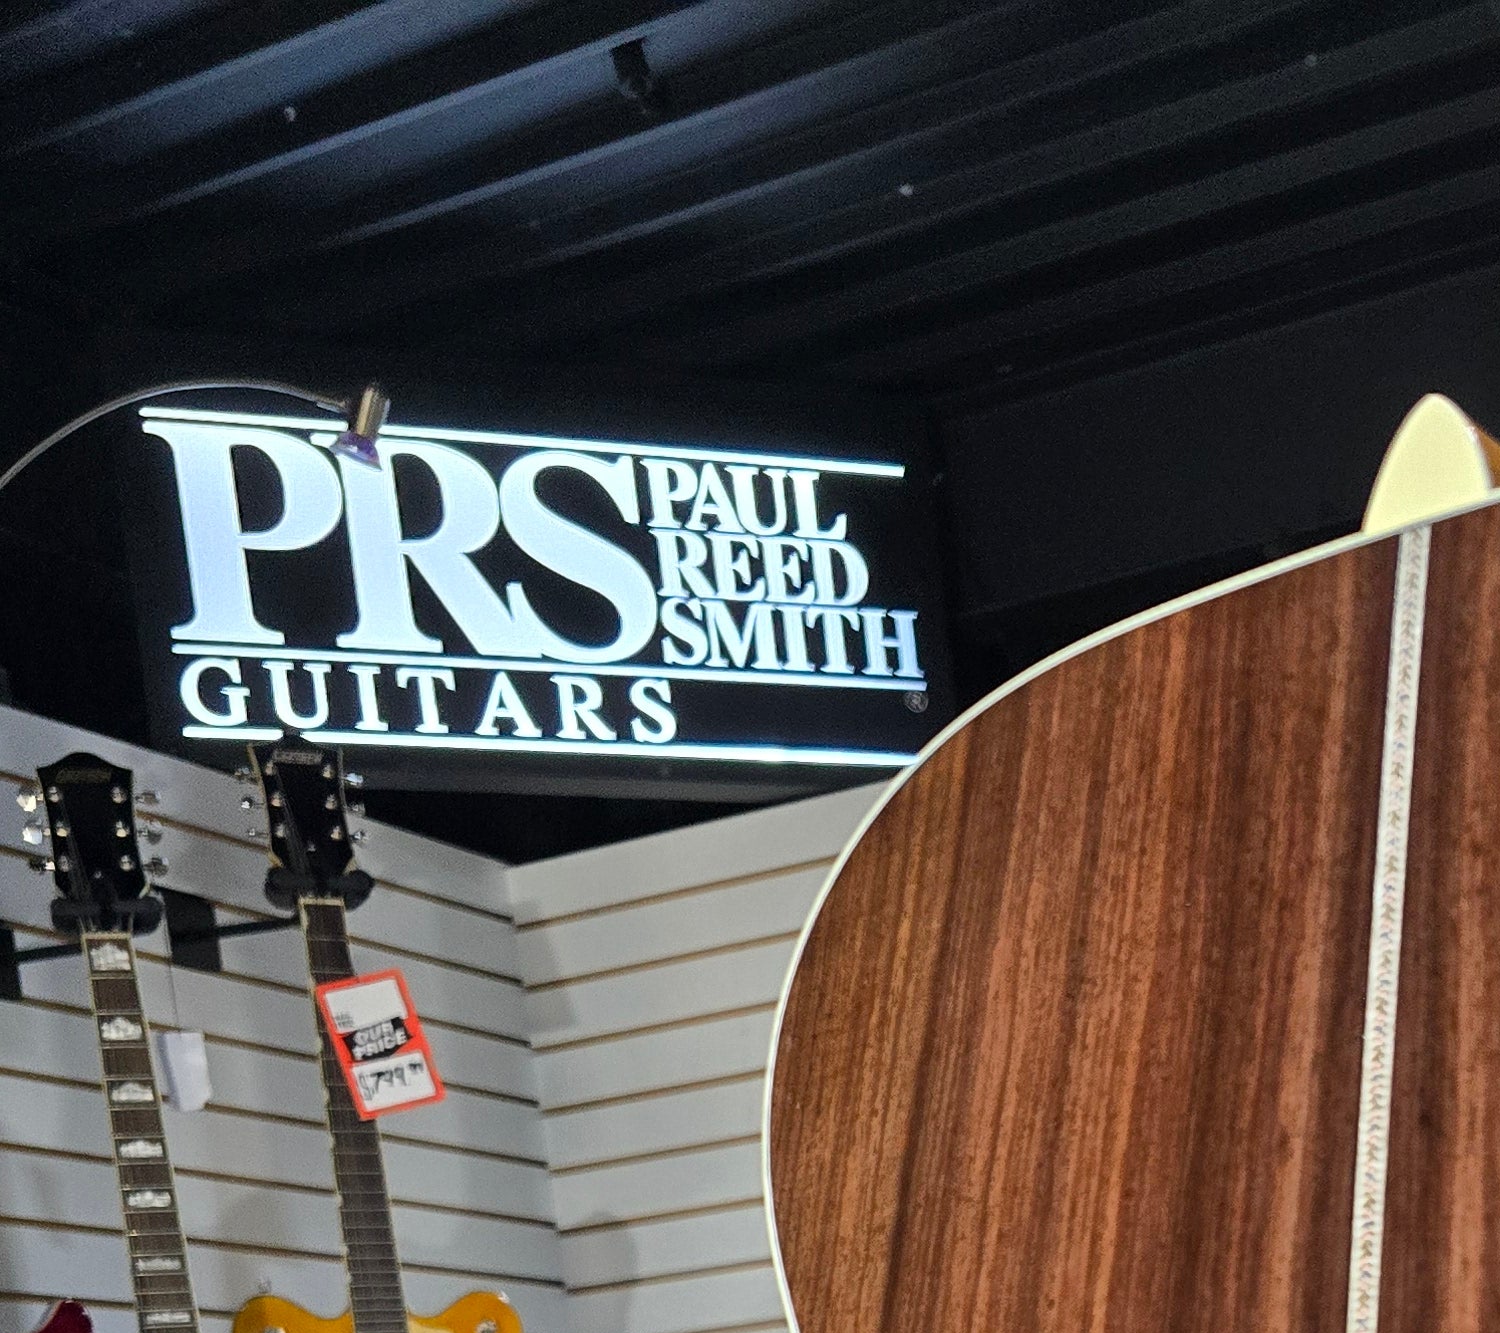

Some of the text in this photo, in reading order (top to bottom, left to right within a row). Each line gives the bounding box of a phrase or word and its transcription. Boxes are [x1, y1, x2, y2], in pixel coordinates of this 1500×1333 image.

[639, 457, 847, 541] PAUL
[142, 419, 659, 664] PRS
[655, 529, 870, 608] REED
[660, 599, 921, 679] SMITH
[179, 657, 679, 745] GUITARS
[351, 1027, 407, 1061] PRICE
[353, 1021, 396, 1047] OUR
